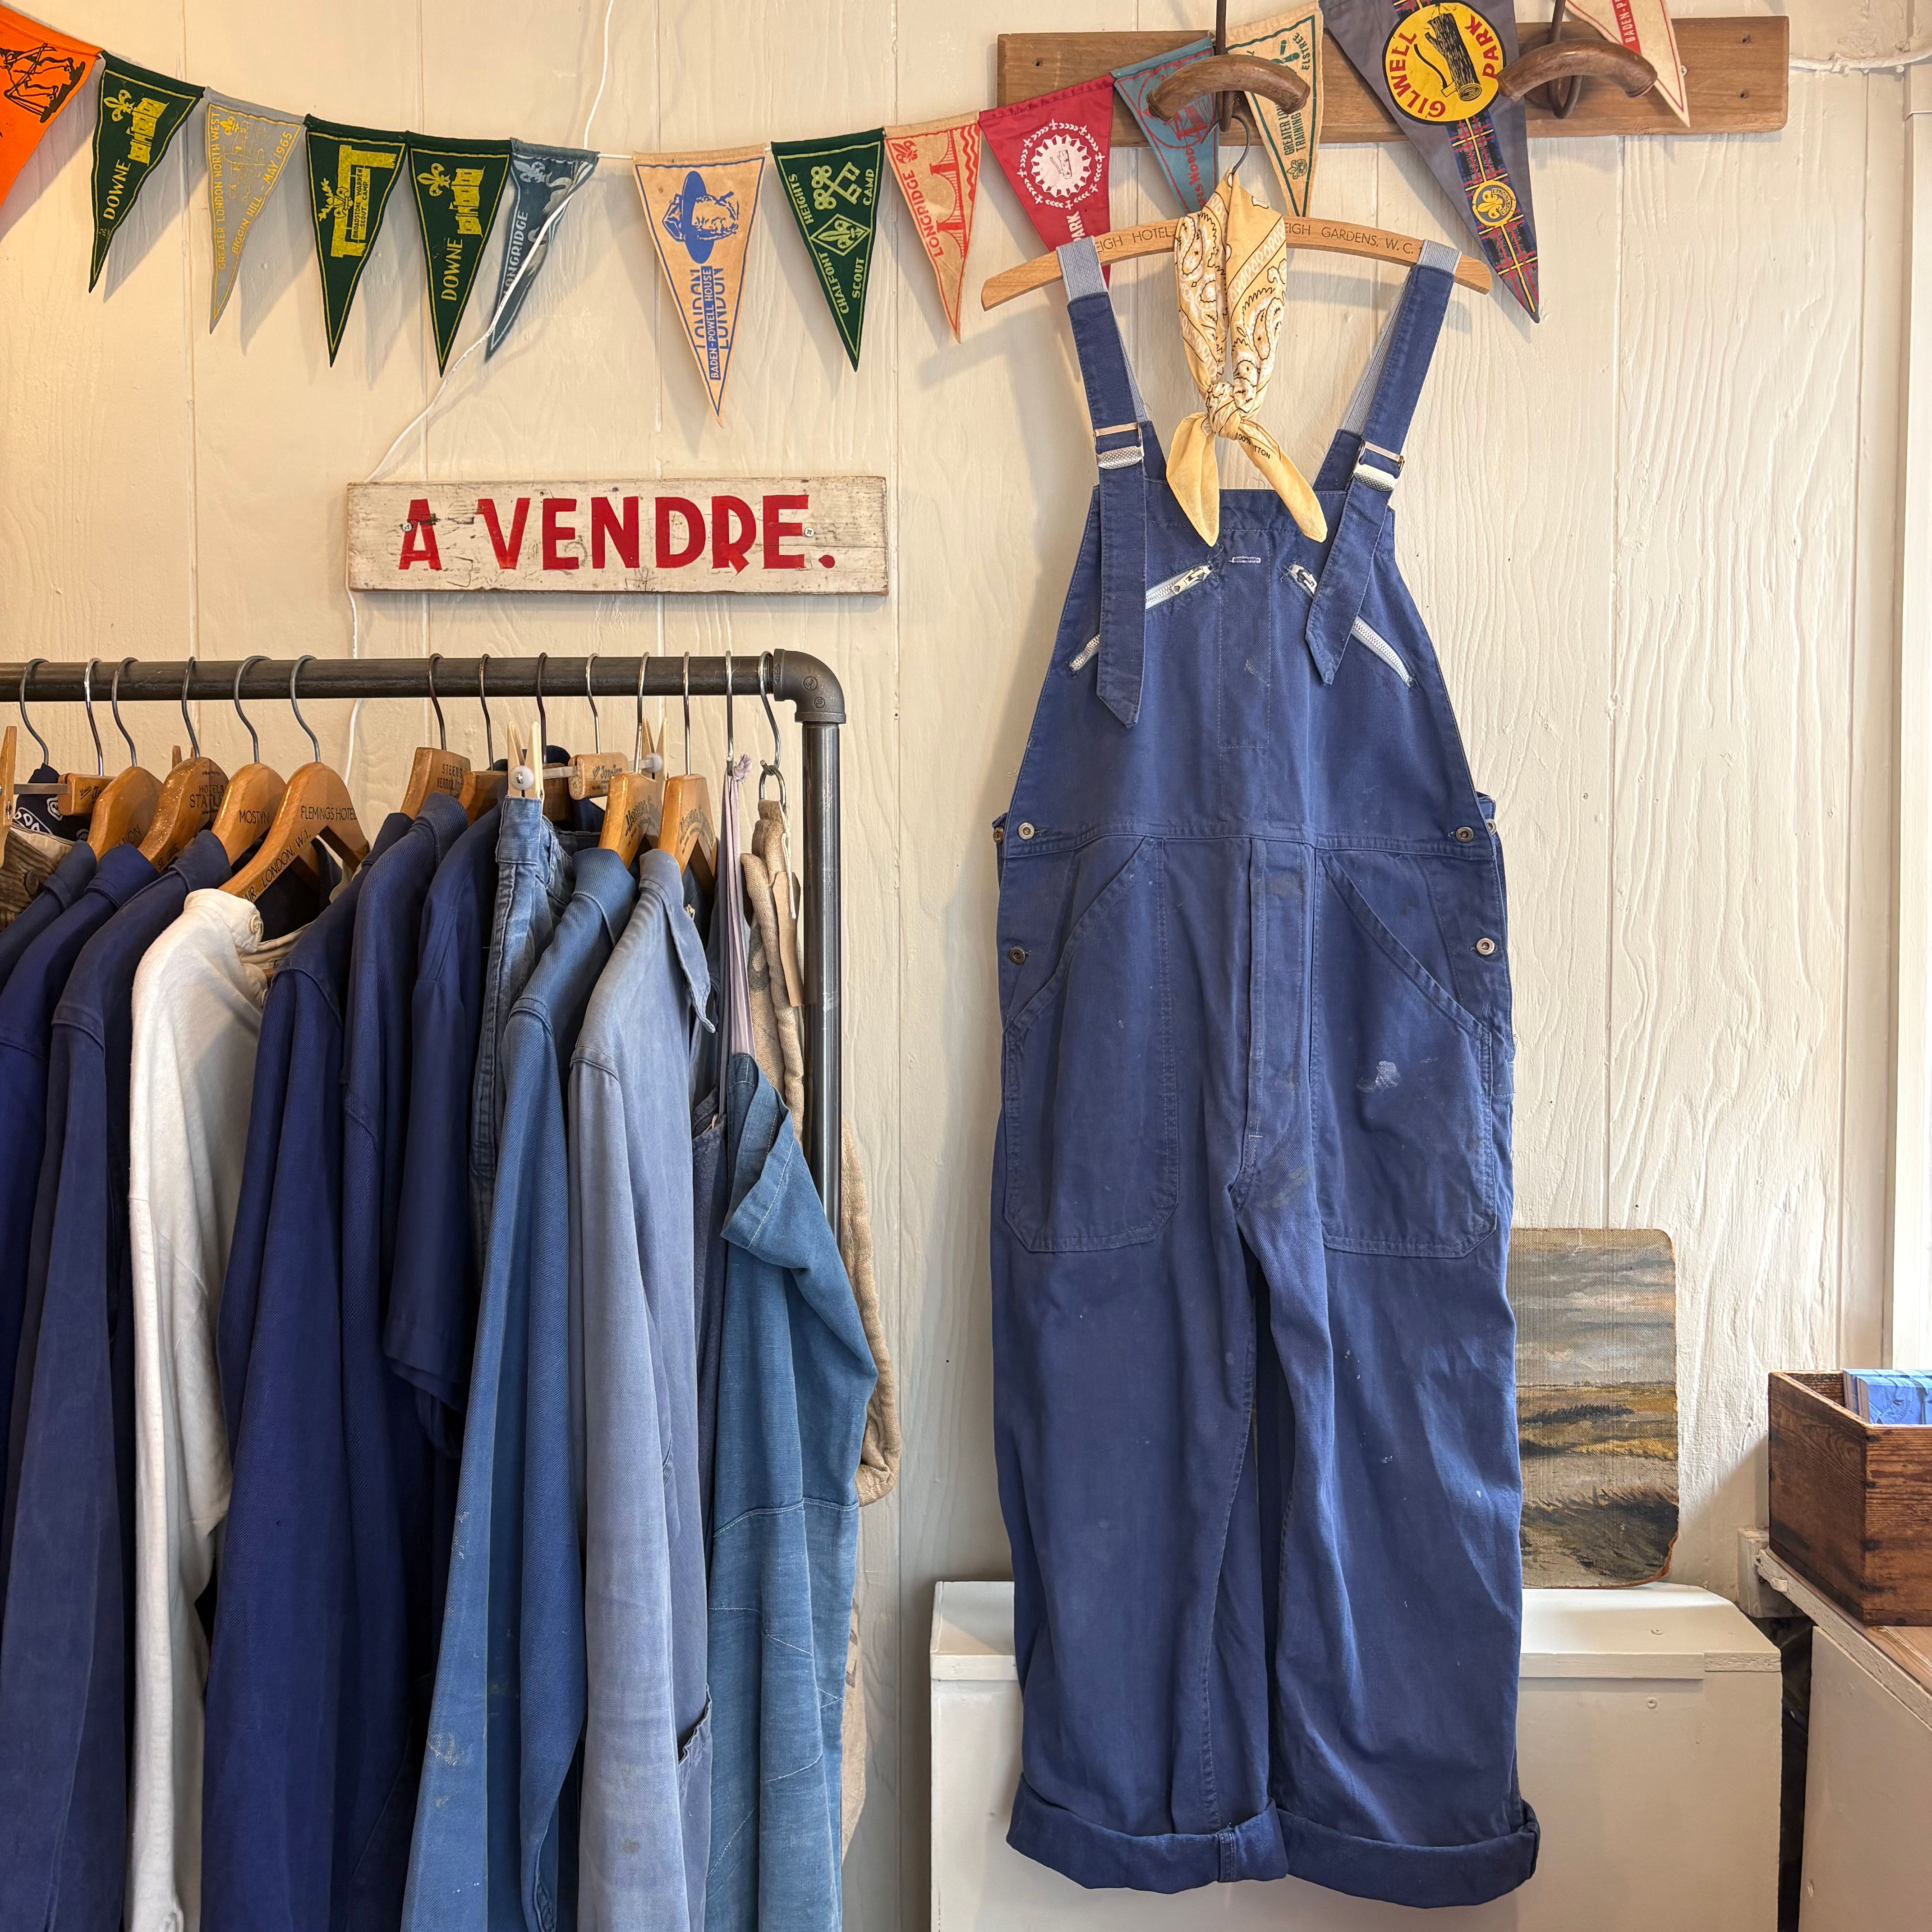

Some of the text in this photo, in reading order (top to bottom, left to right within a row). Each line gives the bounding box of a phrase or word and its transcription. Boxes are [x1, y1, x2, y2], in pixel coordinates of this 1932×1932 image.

[1615, 0, 1636, 43] BADEN-P
[1293, 32, 1310, 70] ELSTREE
[1389, 14, 1499, 117] GILWELL PARK
[1280, 123, 1294, 156] GREATER
[1291, 112, 1306, 152] TRAINING
[103, 159, 131, 220] DOWNE
[210, 112, 225, 269] GREATER LONDON NORTH WEST
[232, 218, 250, 255] BIGGIN
[246, 197, 262, 217] HILL
[263, 160, 278, 185] MAY
[274, 131, 292, 159] 1965
[353, 201, 361, 239] BROADSTONE
[902, 170, 944, 258] LONGRIDGE
[1066, 211, 1086, 242] ARK
[789, 173, 849, 314] CHALFONT HEIGHTS
[1321, 226, 1379, 248] GARDENS,
[441, 237, 463, 301] DOWNE
[702, 268, 713, 301] HOUSE
[851, 257, 865, 299] SCOUT
[398, 494, 836, 576] A VENDRE.
[239, 810, 269, 823] MOSTYN
[301, 806, 357, 820] FLEMINGS HOTEL
[119, 824, 141, 846] TION
[261, 845, 295, 888] LONDON,
